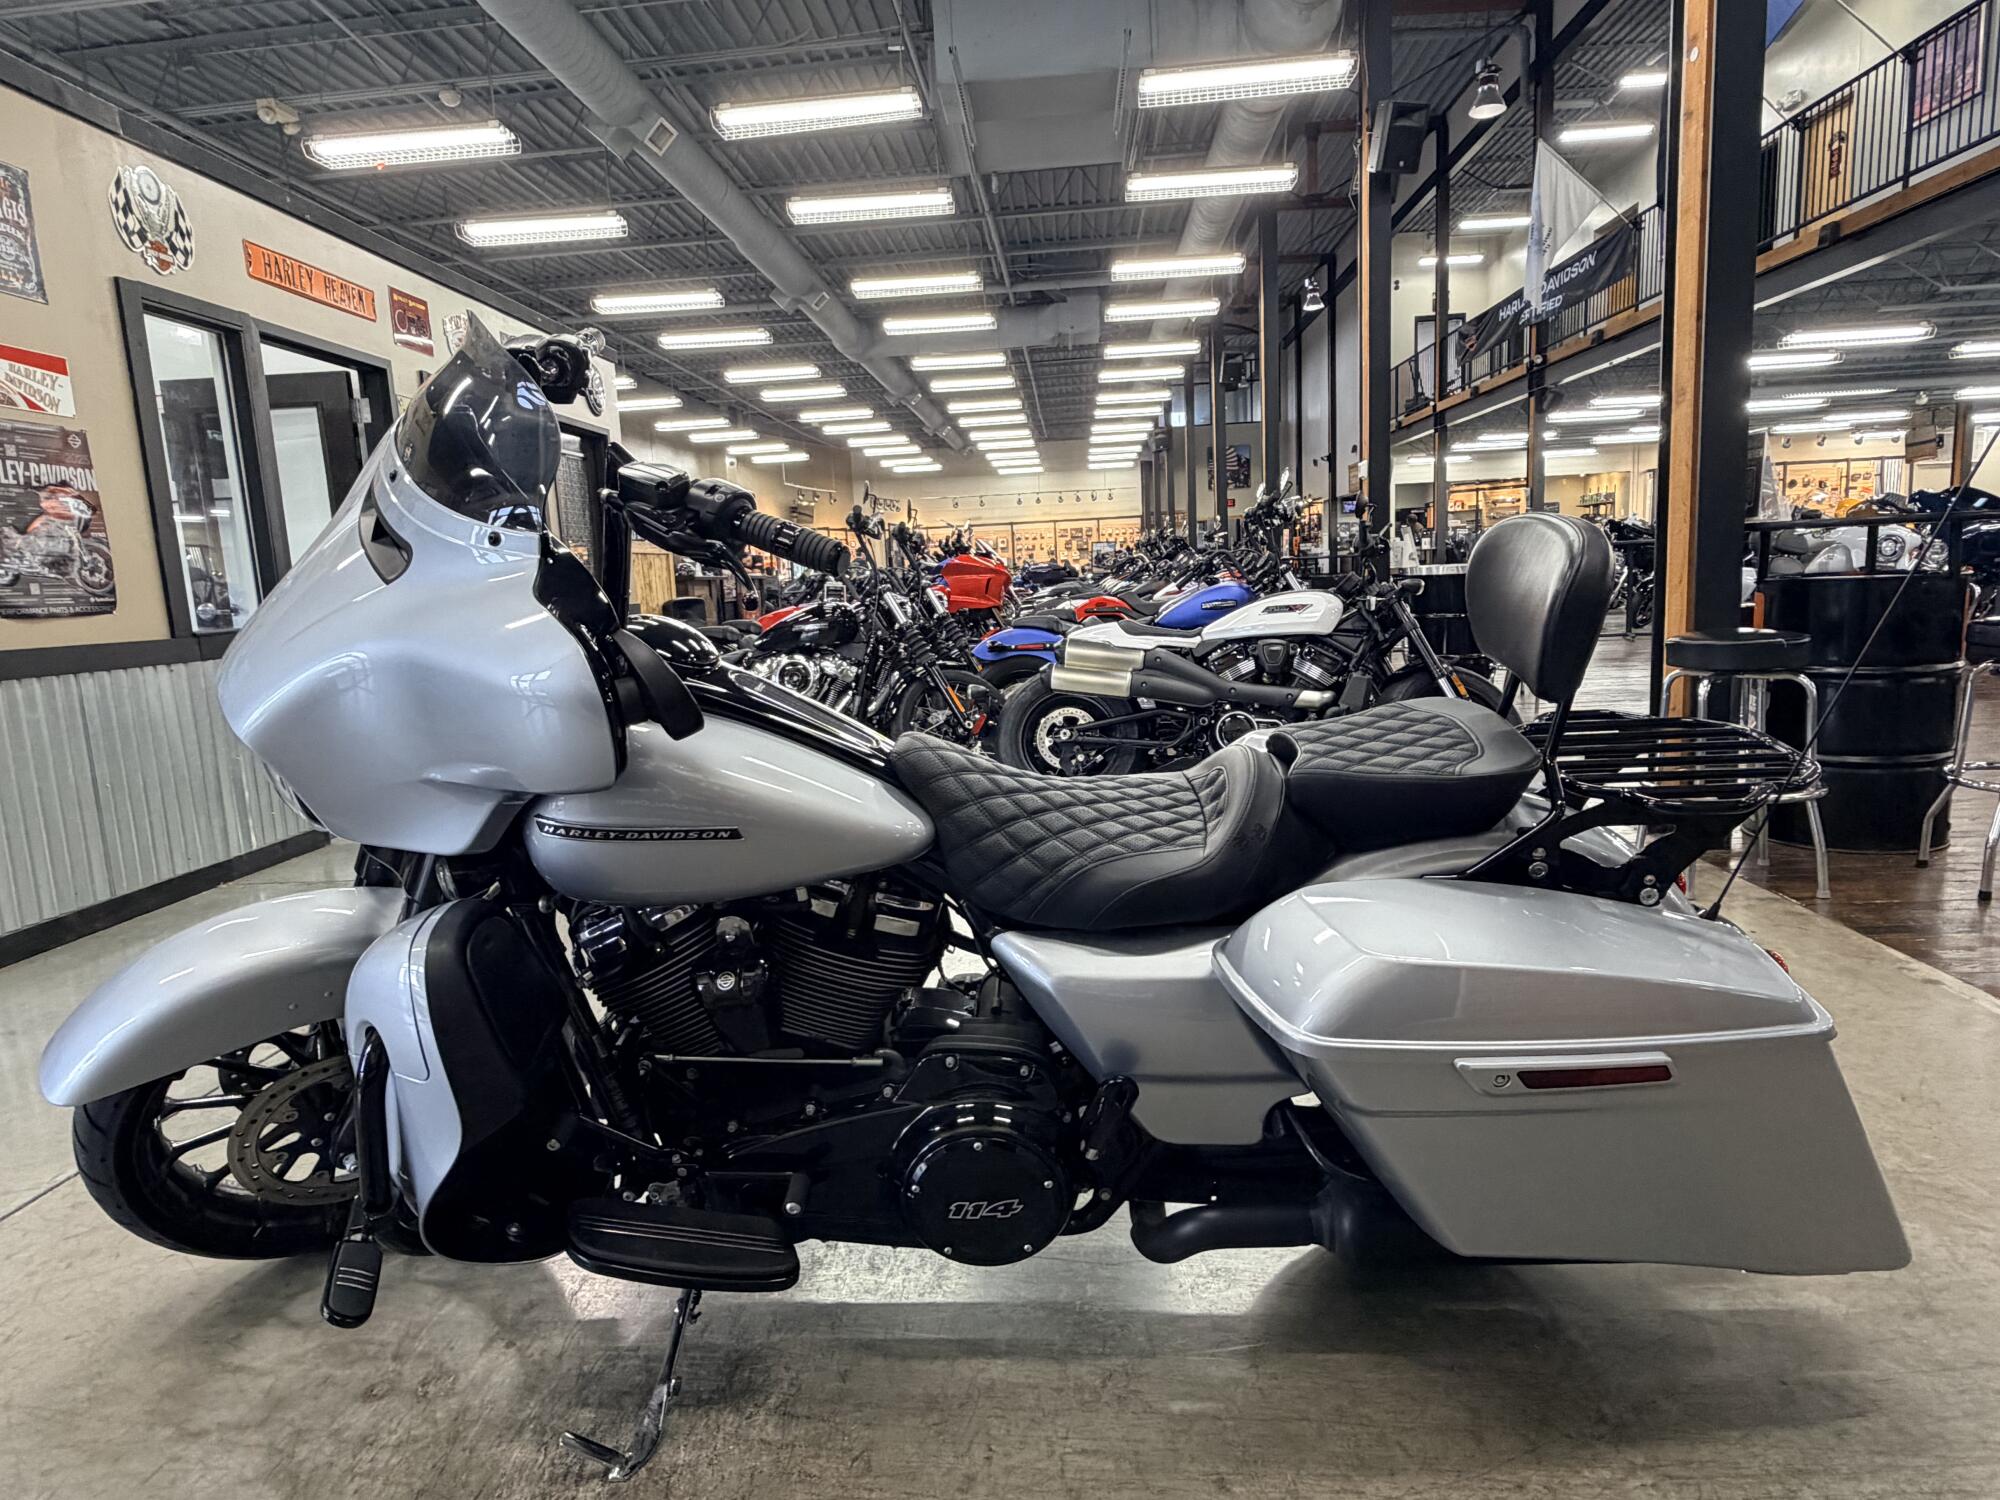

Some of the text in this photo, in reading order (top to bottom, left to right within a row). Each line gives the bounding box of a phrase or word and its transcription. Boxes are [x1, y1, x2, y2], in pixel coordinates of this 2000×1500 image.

[260, 250, 367, 315] HARLEY HEAVEN
[7, 362, 64, 391] HARLEY-
[4, 371, 61, 414] DAVIDSON
[542, 824, 731, 840] HARLEY-DAVIDSON
[948, 1198, 1024, 1220] 114
